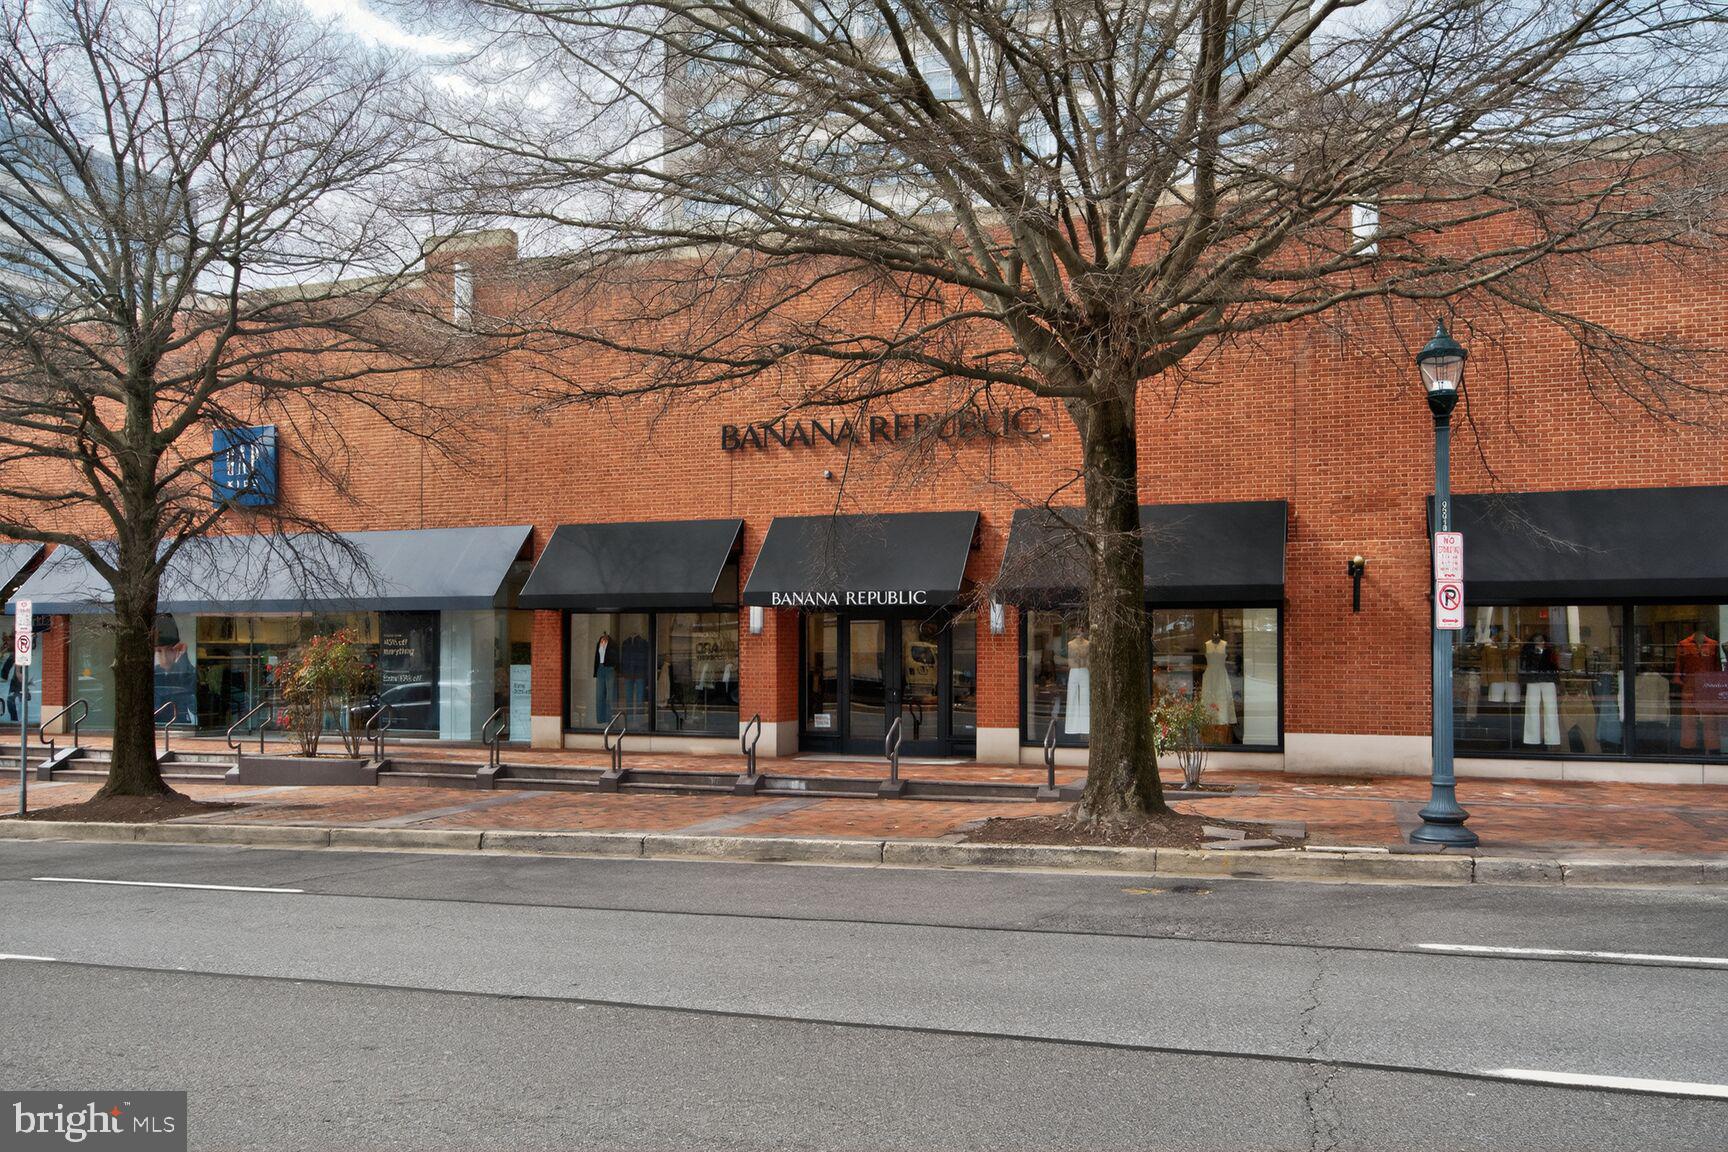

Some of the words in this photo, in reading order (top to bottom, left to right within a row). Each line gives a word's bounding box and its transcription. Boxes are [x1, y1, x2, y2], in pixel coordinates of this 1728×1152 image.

[721, 418, 860, 450] BANANA
[1443, 536, 1456, 545] NO
[772, 591, 839, 606] BANANA
[846, 590, 927, 606] REPUBLIC
